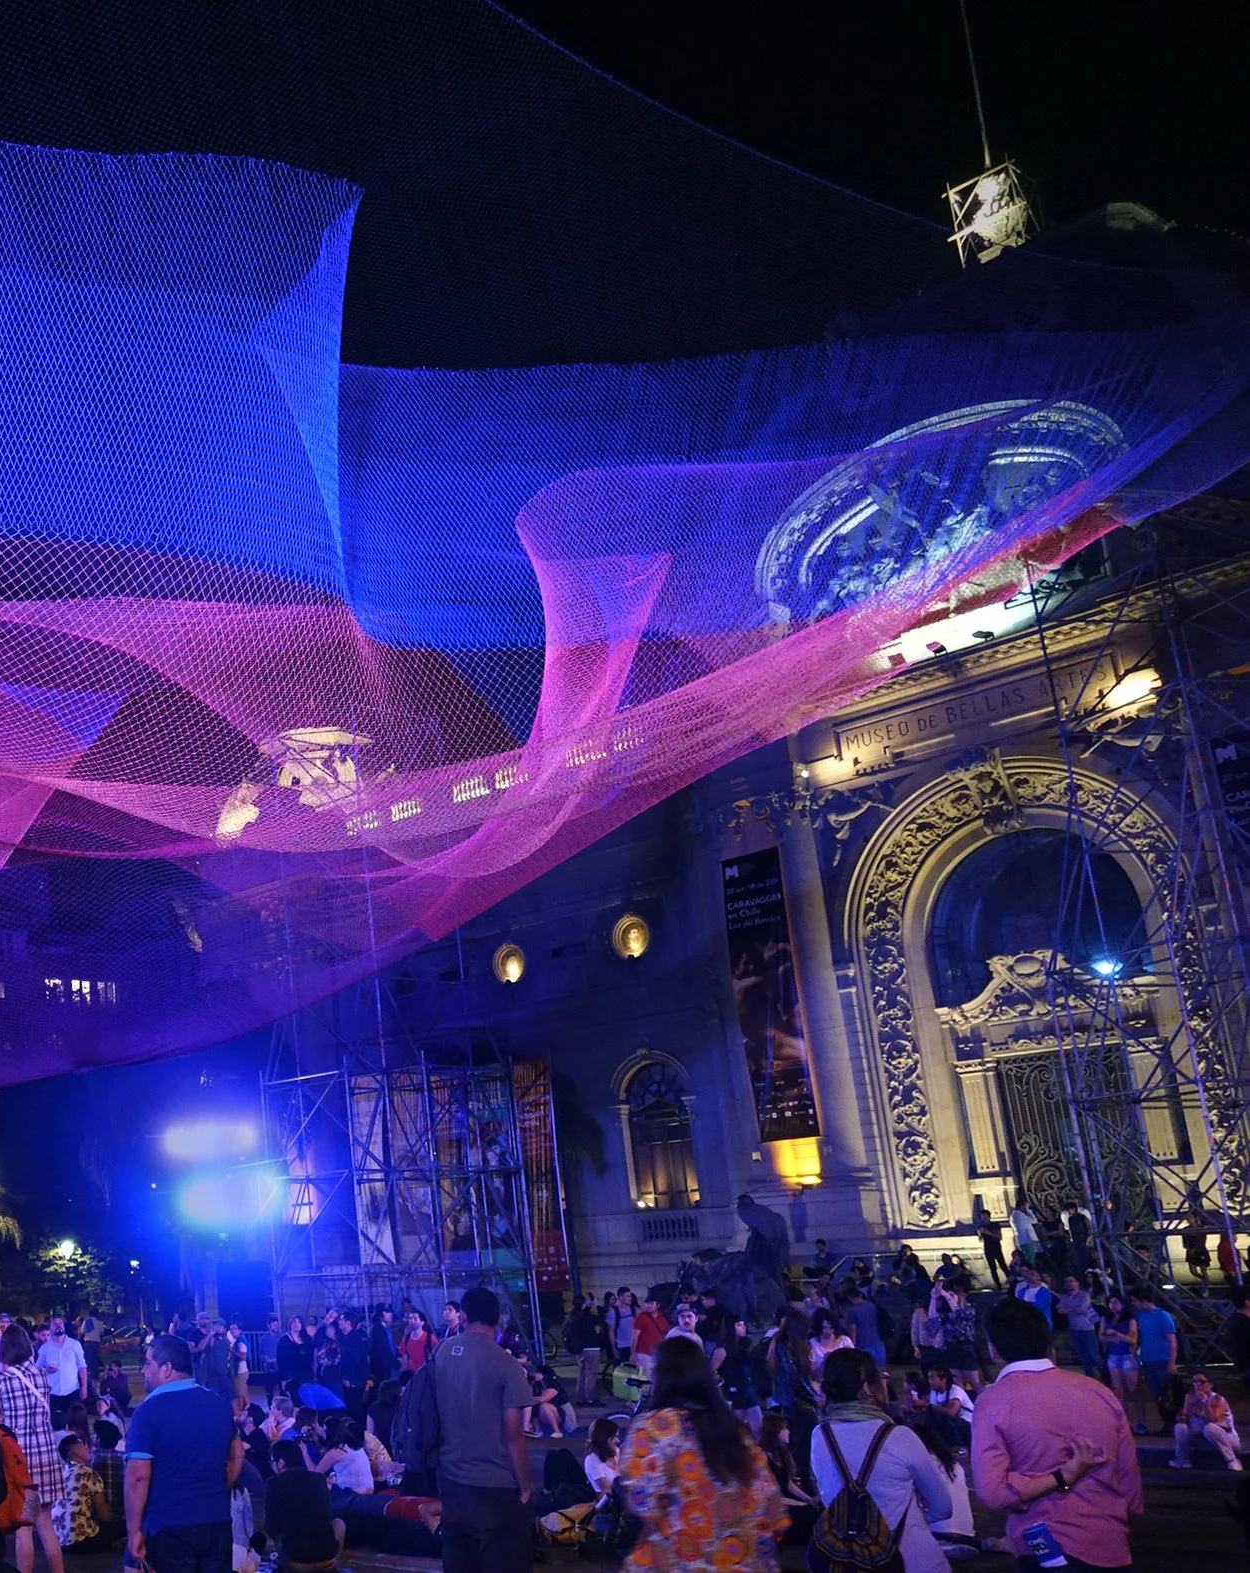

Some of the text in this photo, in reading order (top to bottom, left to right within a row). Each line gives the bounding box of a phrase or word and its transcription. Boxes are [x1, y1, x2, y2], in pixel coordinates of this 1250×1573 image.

[845, 664, 1107, 751] MUSEO DE BELLAS ARTES
